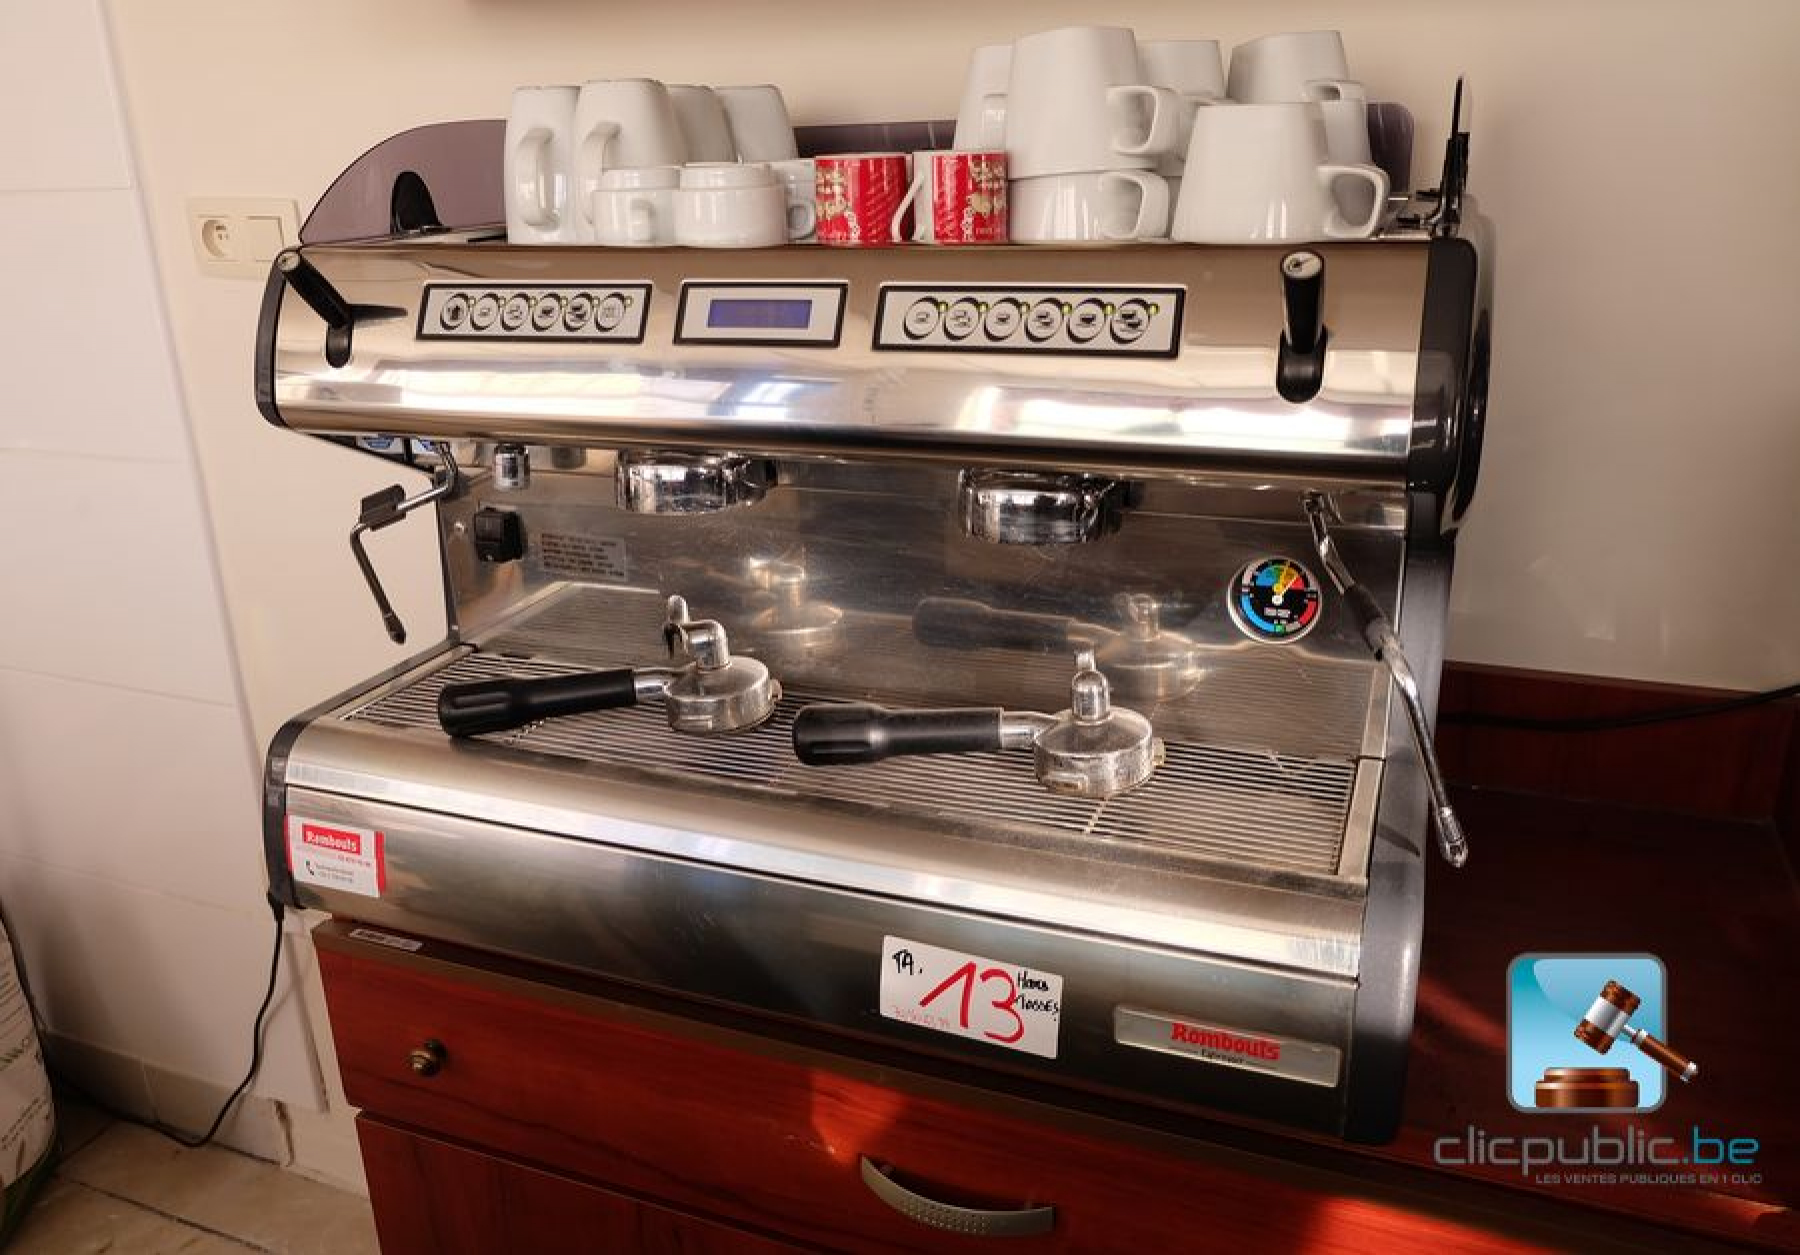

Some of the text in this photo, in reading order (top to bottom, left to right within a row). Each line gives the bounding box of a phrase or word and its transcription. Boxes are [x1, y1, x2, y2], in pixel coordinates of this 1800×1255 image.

[305, 830, 357, 852] Rombouts
[919, 960, 1025, 1044] 13
[1171, 1022, 1281, 1060] Rombouts
